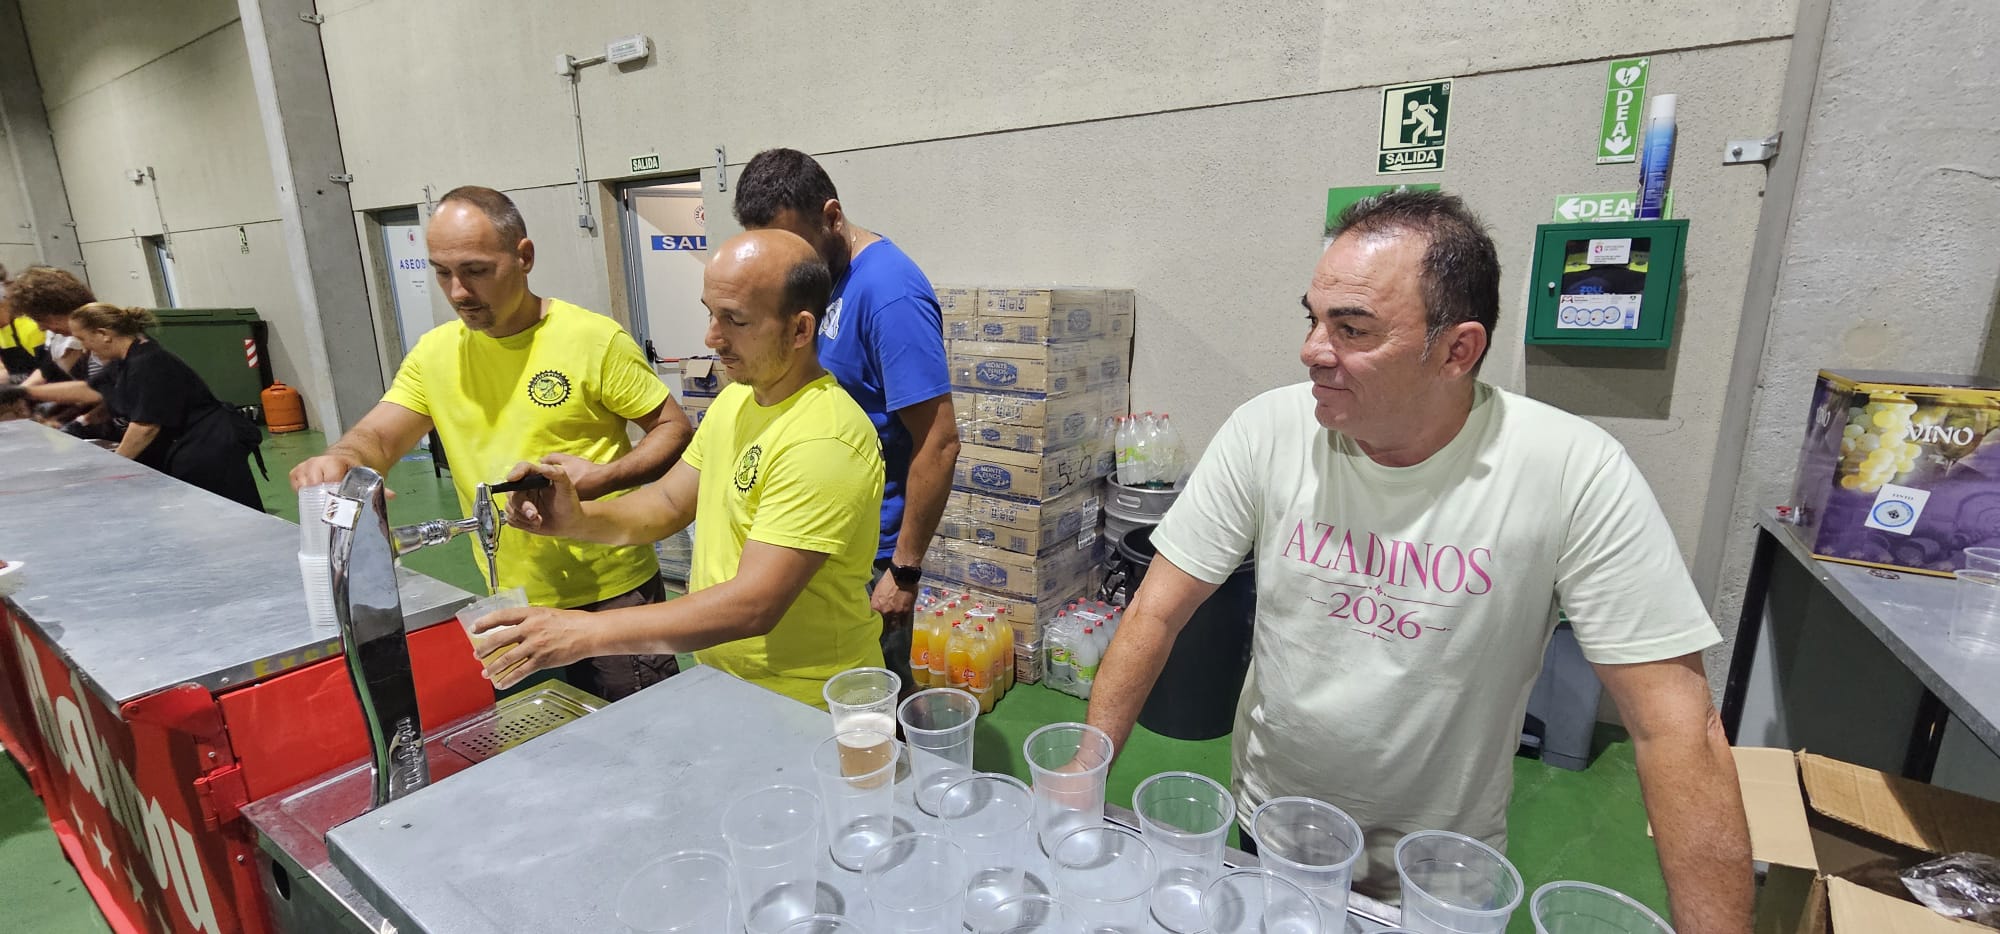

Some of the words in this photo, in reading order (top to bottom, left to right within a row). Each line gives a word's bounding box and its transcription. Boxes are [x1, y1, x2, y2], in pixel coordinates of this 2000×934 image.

[1611, 89, 1634, 137] DEA
[632, 156, 659, 171] SALIDA
[1385, 150, 1437, 165] SALIDA
[1579, 198, 1633, 218] DEA
[662, 236, 707, 250] SAL
[400, 258, 426, 270] ASEOS
[1906, 423, 1975, 446] VINO
[980, 465, 1003, 475] MONTE
[1280, 518, 1492, 595] AZADINOS
[1328, 592, 1422, 639] 2026
[6, 606, 223, 934] Mahou
